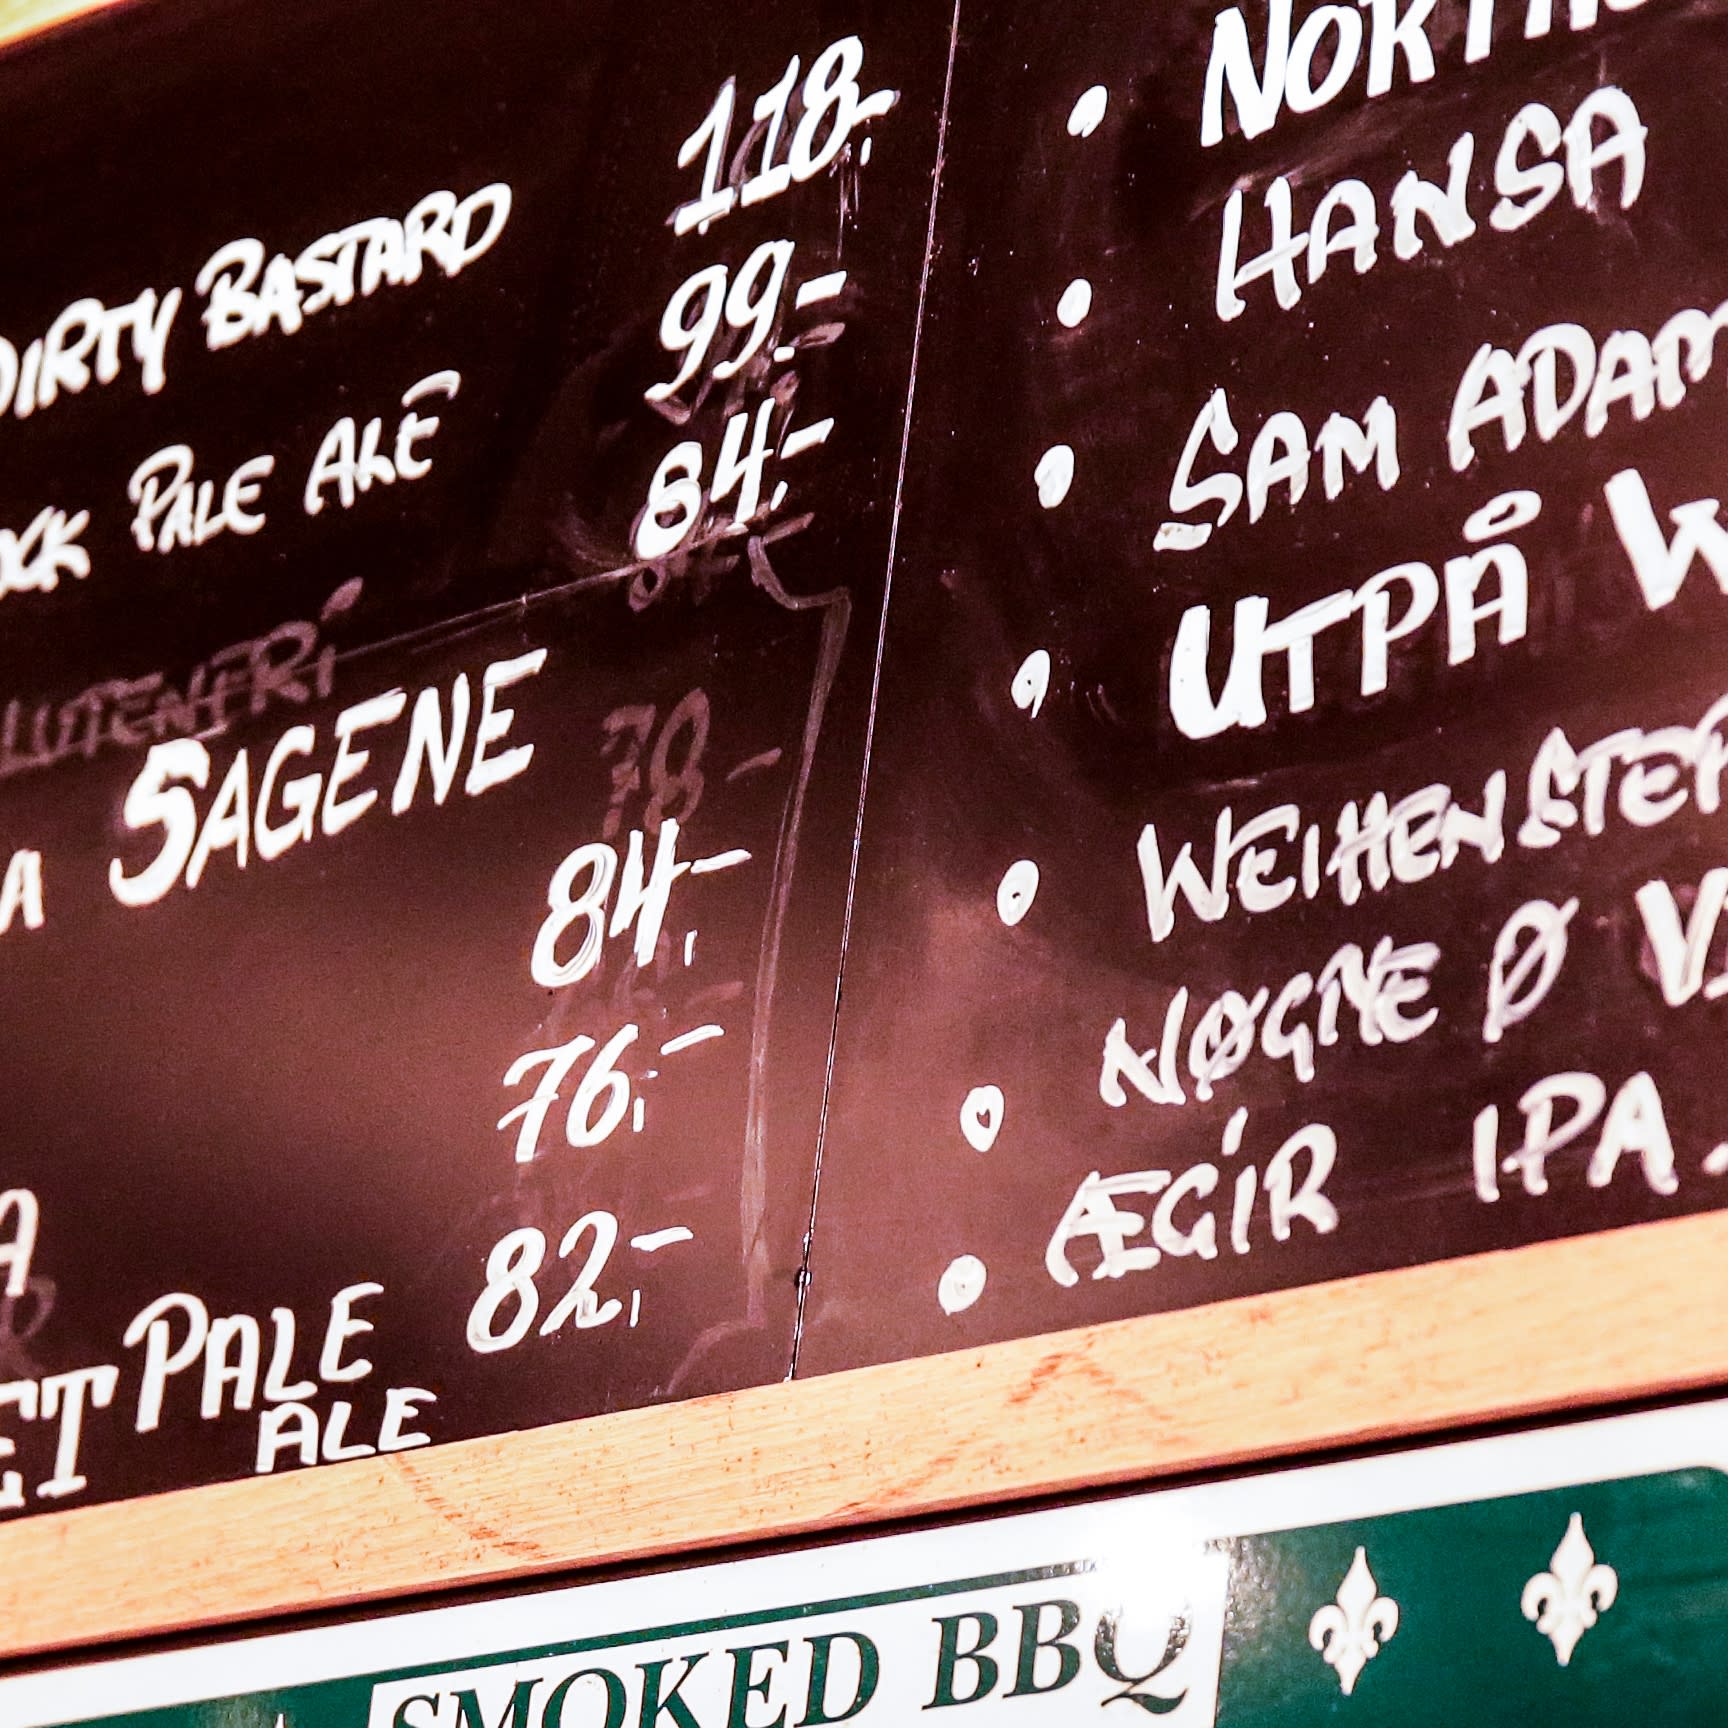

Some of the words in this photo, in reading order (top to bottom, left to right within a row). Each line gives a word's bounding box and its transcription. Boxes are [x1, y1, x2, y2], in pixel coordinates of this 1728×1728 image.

[195, 182, 513, 351] BASTARD
[1214, 86, 1648, 322] HANSA
[127, 443, 275, 554] PALE
[304, 369, 462, 516] ALE
[1153, 387, 1400, 551] SAM
[1167, 490, 1541, 741] UTPÅ
[108, 647, 549, 909] SAGENE
[1097, 935, 1441, 1110] NØGNE
[1479, 898, 1578, 1044] Ø
[121, 1280, 386, 1434] PALE
[254, 1386, 437, 1476] ALE
[922, 1598, 1192, 1716] BBQ
